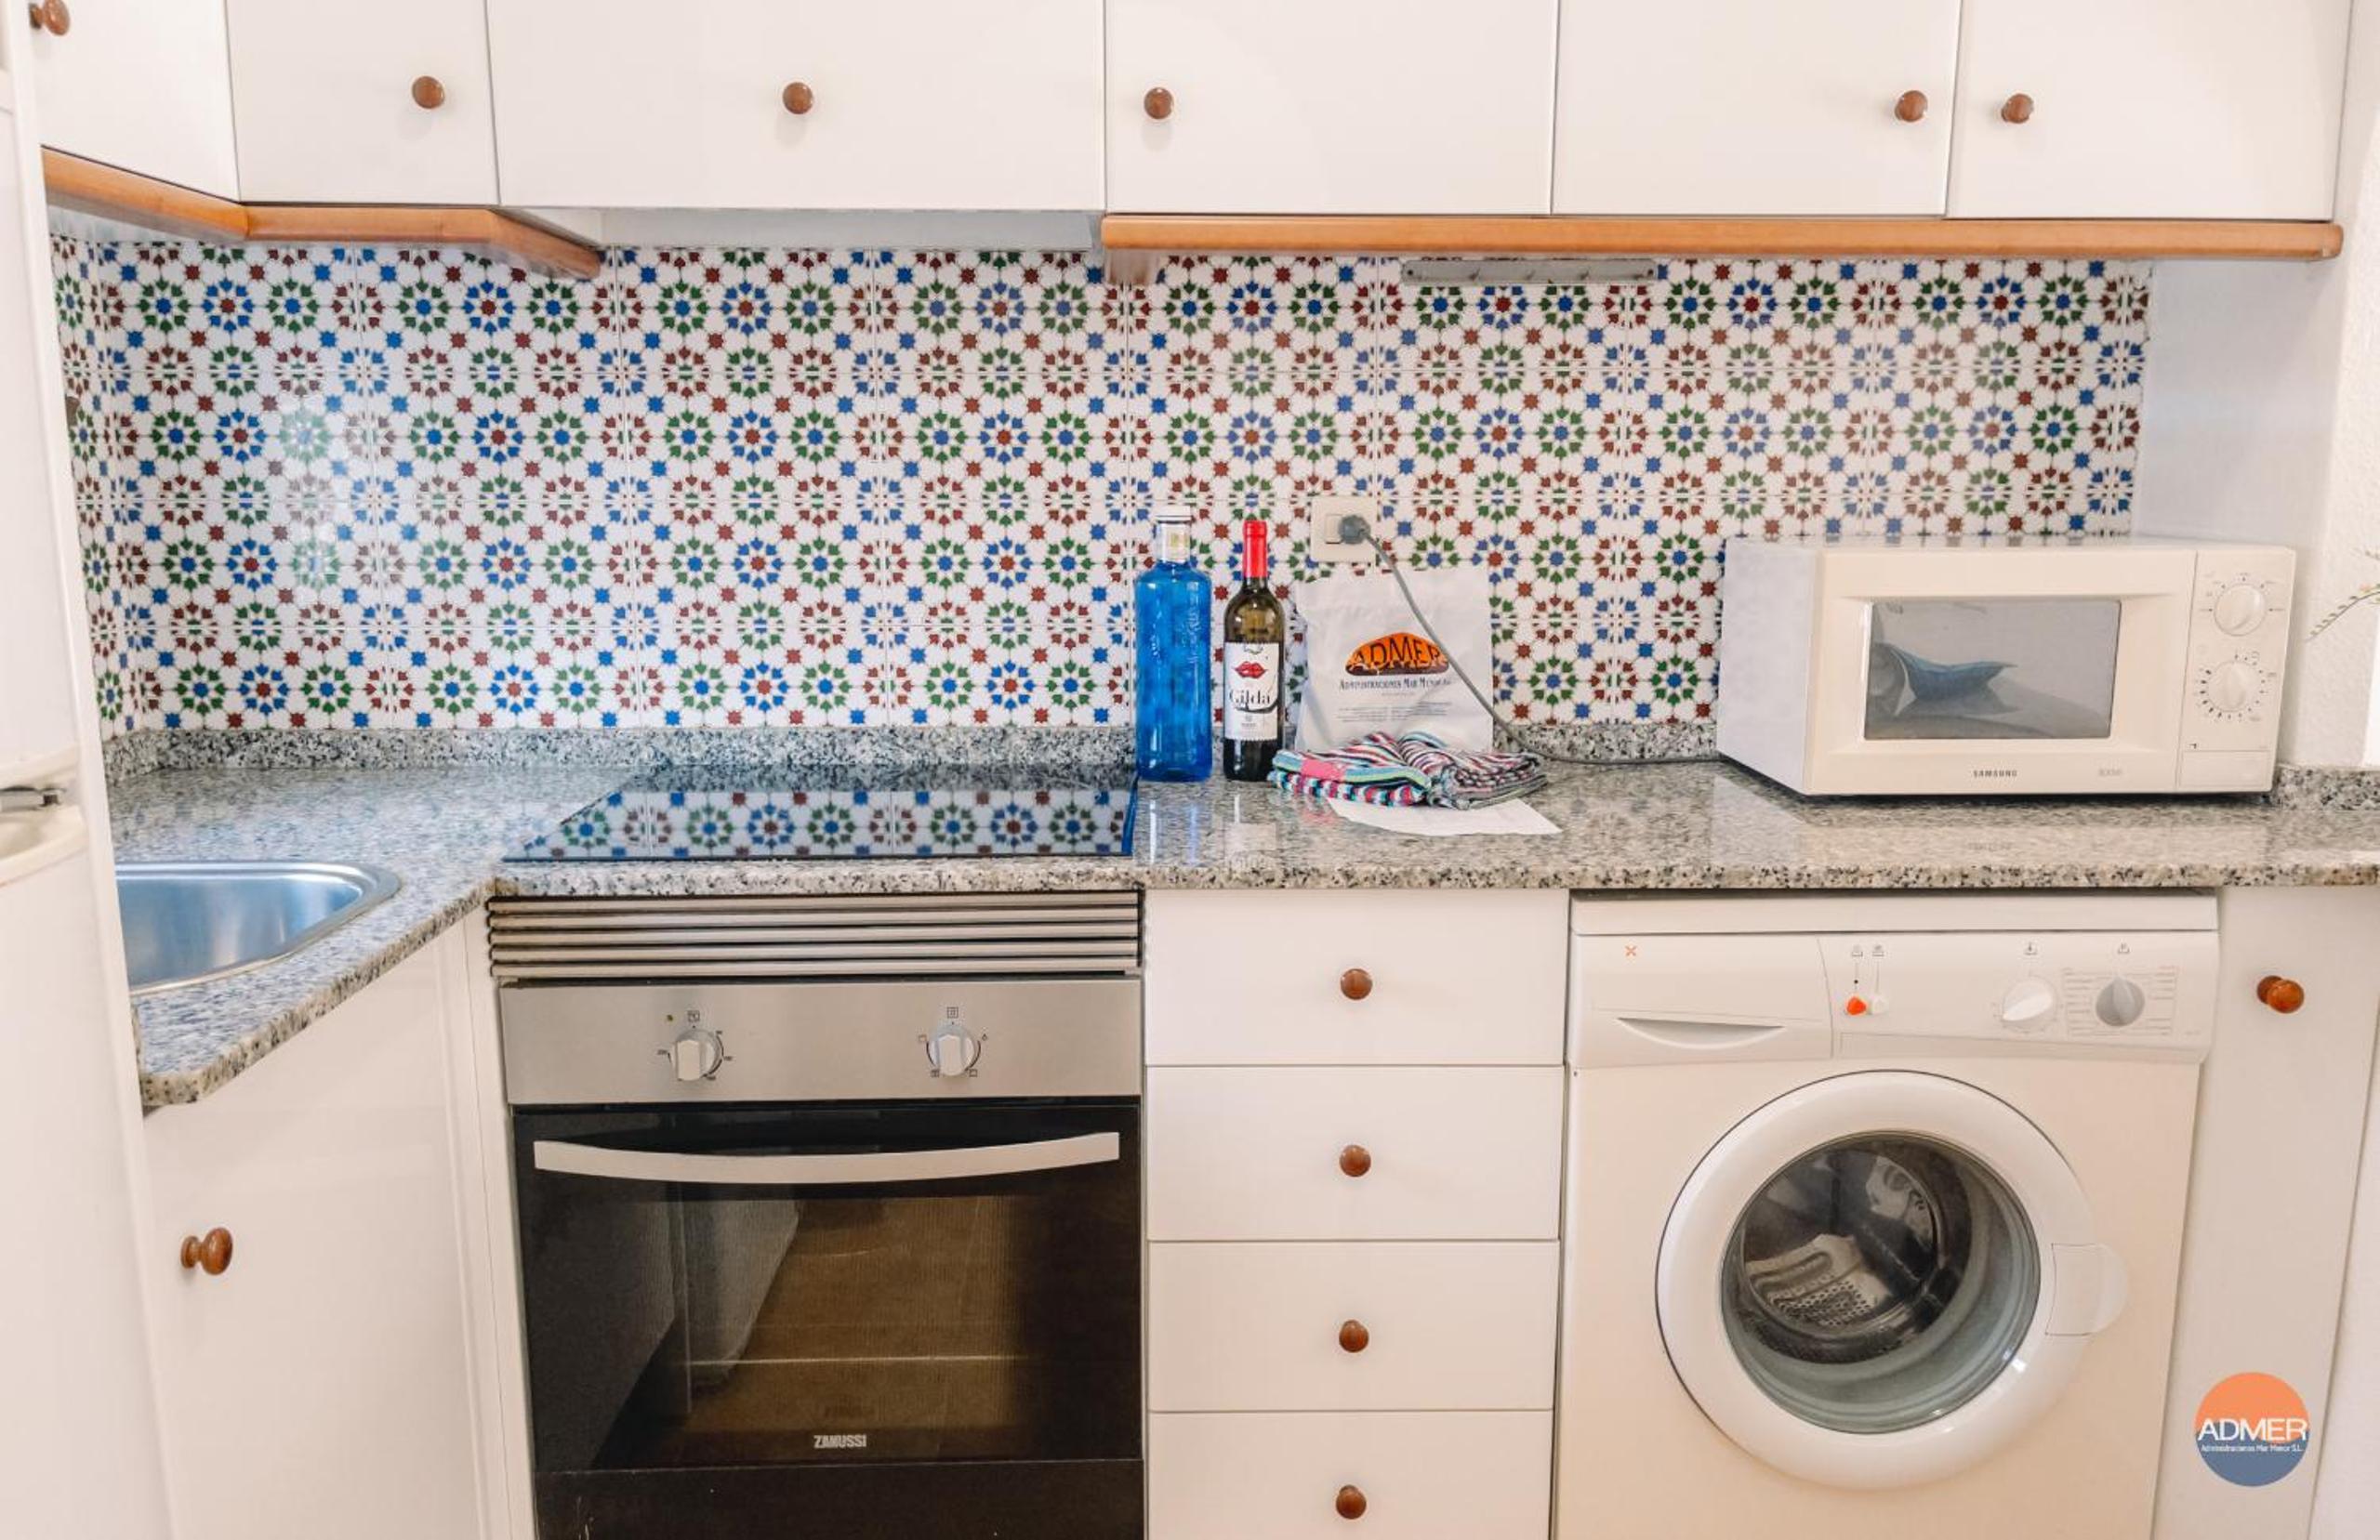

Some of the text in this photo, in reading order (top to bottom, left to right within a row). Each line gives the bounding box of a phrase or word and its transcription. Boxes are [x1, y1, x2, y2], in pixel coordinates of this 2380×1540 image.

[1354, 636, 1444, 667] ADMER
[1229, 690, 1270, 705] Gilda
[1973, 770, 2018, 778] SAMSUNG
[813, 1433, 867, 1449] ZANUSSI
